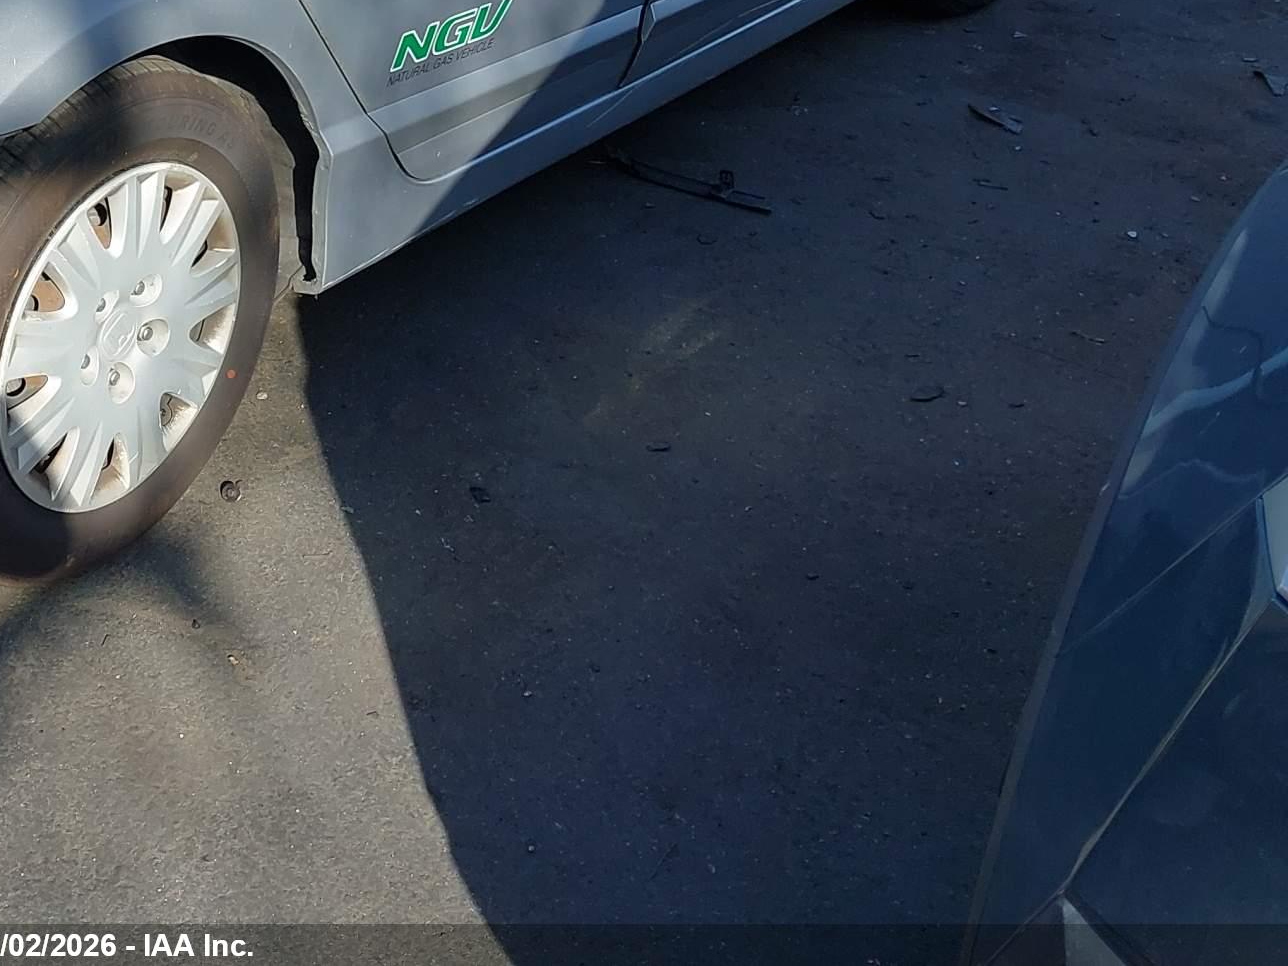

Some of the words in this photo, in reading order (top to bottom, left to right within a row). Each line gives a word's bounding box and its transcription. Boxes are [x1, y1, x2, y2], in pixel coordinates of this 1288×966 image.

[386, 62, 432, 87] NATURAL
[432, 52, 454, 70] GAS
[455, 37, 495, 62] VEHICLE
